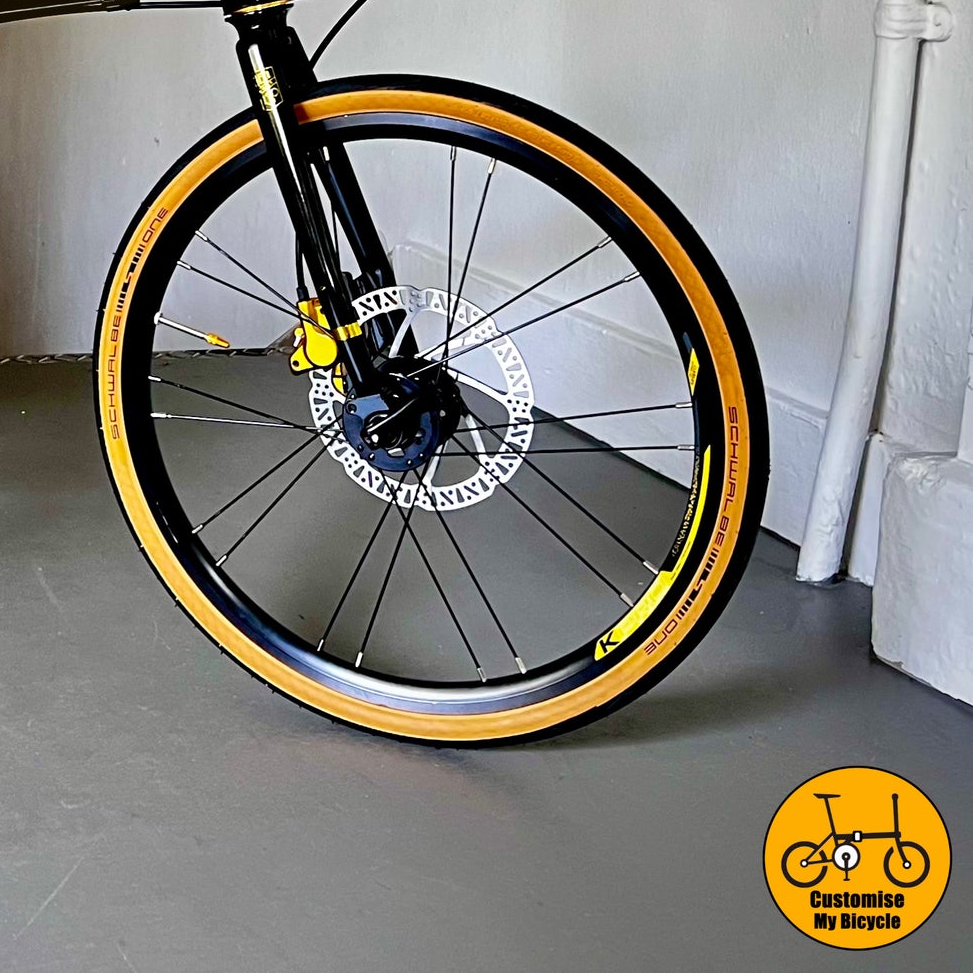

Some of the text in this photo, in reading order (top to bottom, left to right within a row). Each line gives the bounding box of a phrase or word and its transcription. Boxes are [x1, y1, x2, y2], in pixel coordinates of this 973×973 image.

[107, 207, 169, 440] SCHWALBE ONE
[644, 406, 739, 656] SCHWALBE ONE
